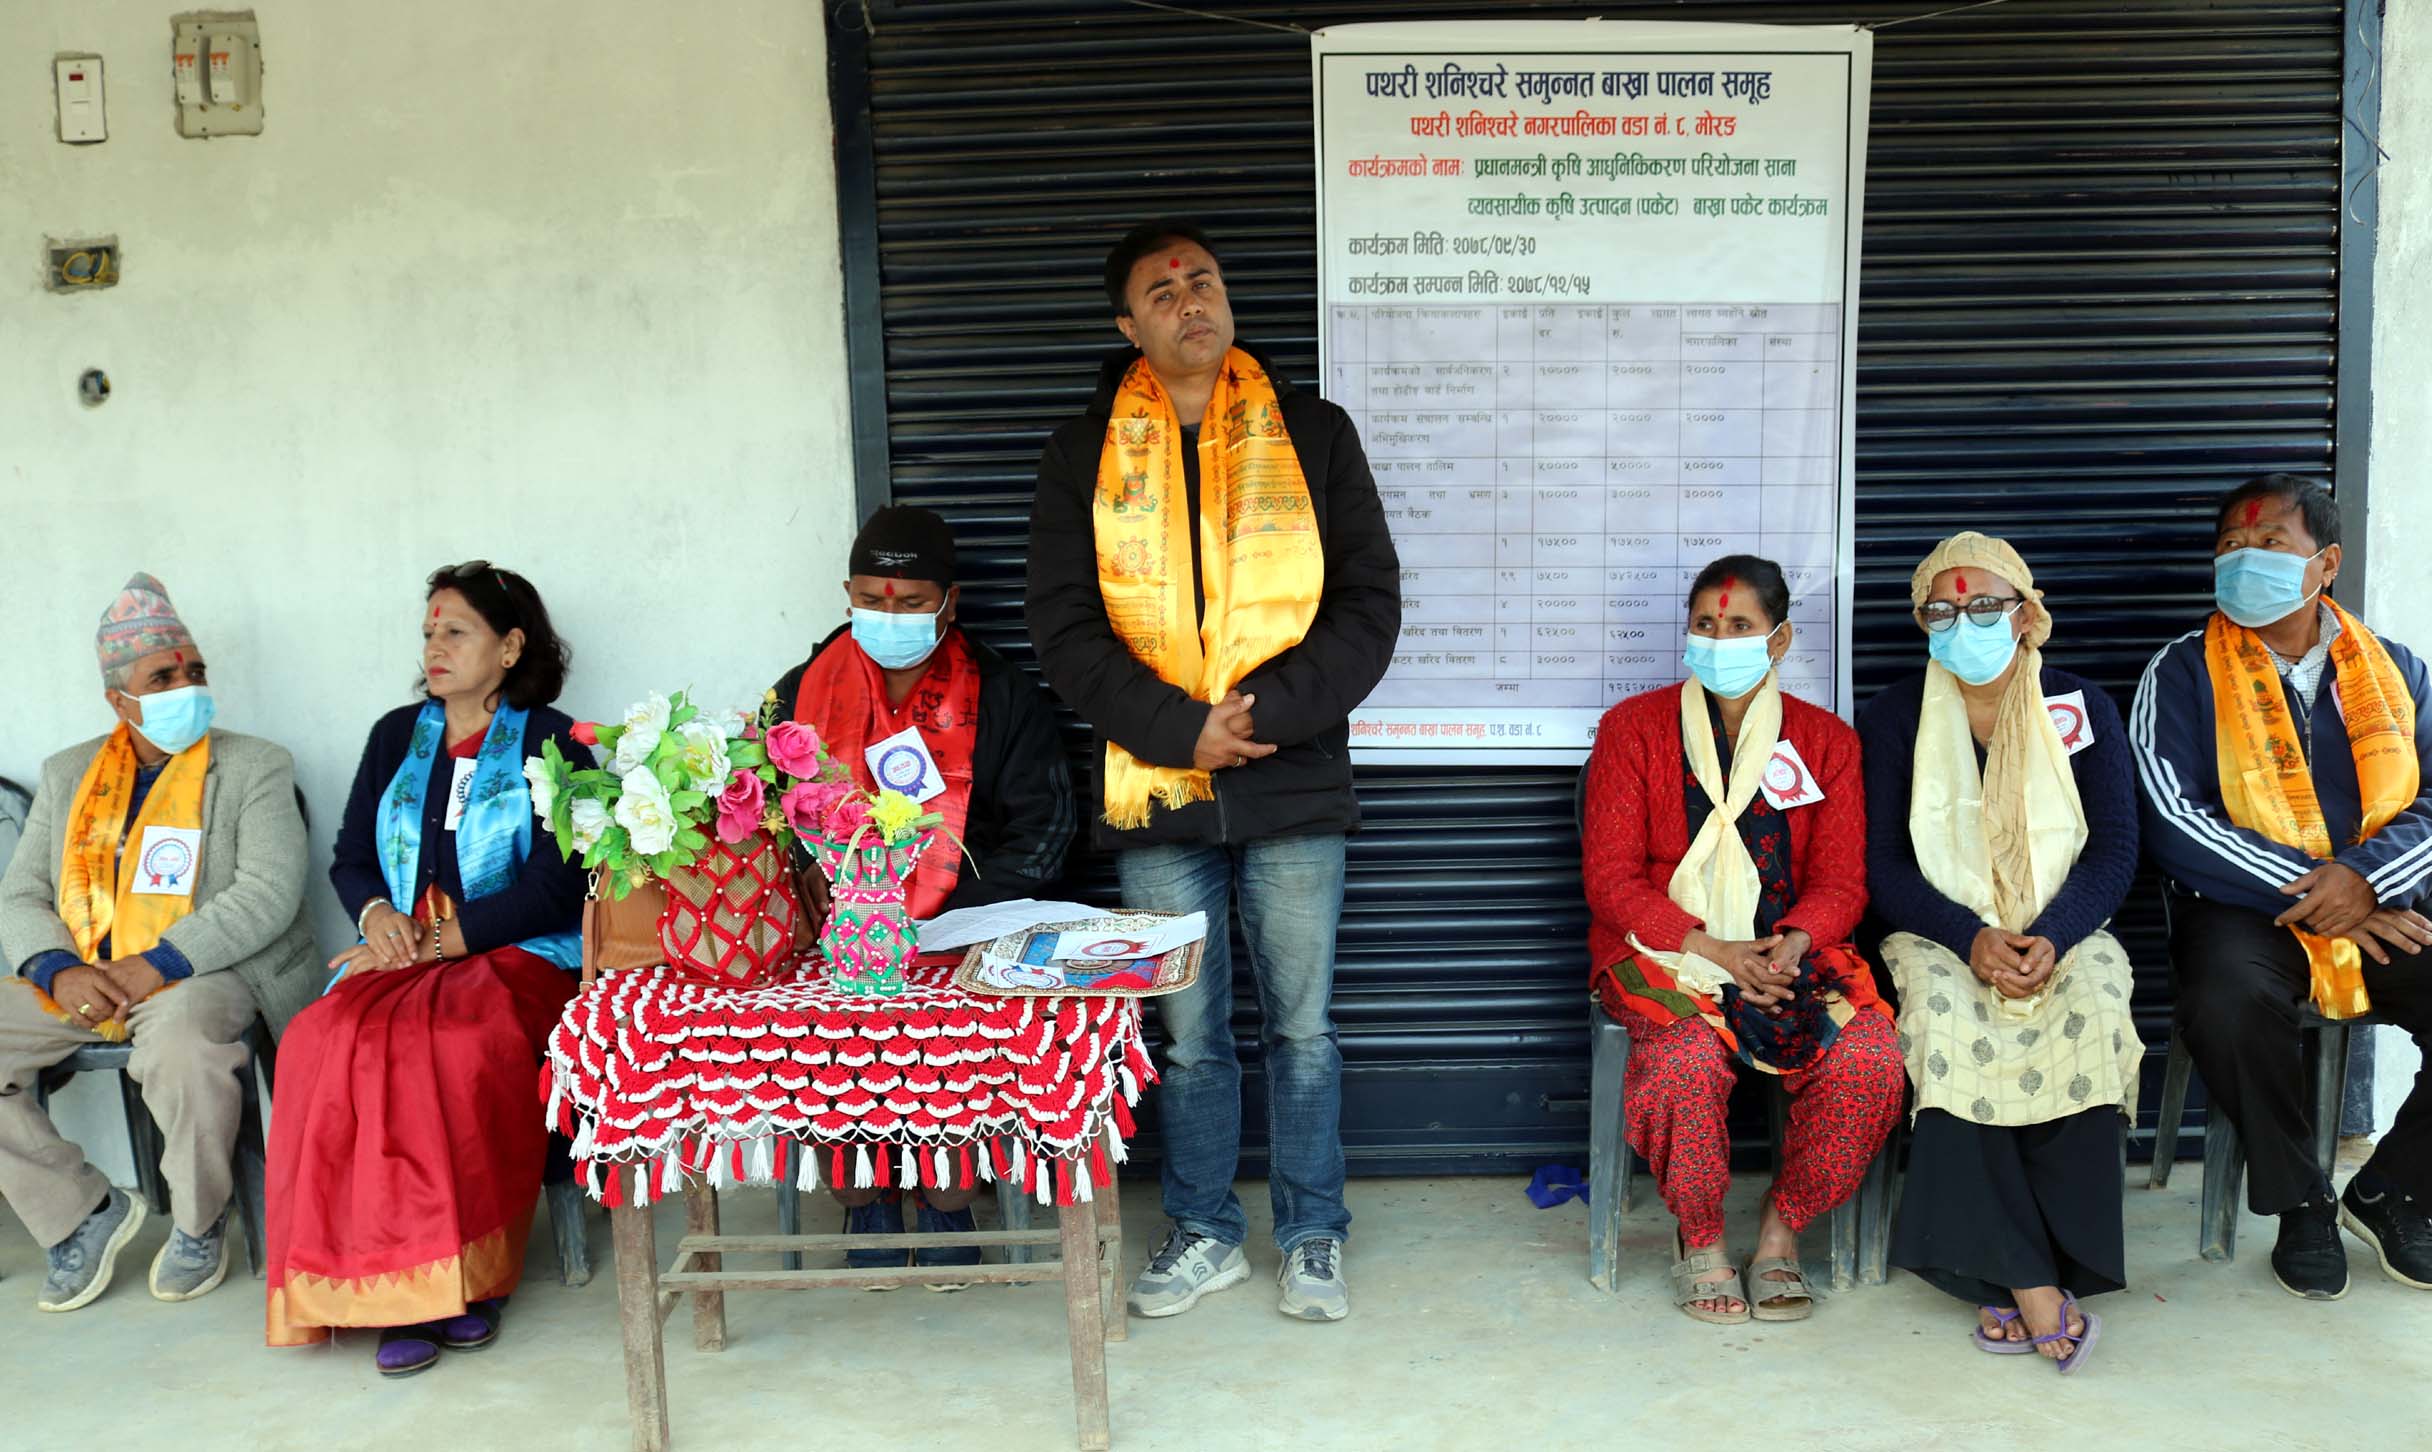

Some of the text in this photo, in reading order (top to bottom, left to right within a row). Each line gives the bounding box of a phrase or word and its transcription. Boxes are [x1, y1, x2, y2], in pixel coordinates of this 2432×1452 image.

[1366, 63, 1772, 105] पथरी शनिश्चरे समुन्नत बाख्रा पालन समूह
[1410, 111, 1450, 137] पथरी
[1456, 110, 1519, 137] शनिश्चरे
[1524, 110, 1616, 137] नगरपालिका
[1622, 116, 1649, 136] वडा
[1349, 153, 1427, 178] कार्यक्रमको
[1475, 153, 1546, 178] प्रधानमन्त्री
[1552, 153, 1581, 181] कृषि
[1587, 152, 1685, 181] आधुनिकिकरण
[1692, 152, 1759, 177] परियोजना
[1764, 159, 1796, 177] साना
[1468, 193, 1541, 217] व्यवसायीक
[1546, 192, 1575, 220] कृषि
[1579, 198, 1631, 217] उत्पादन
[1637, 192, 1679, 216] (पकेट)
[1731, 193, 1763, 216] पकेट
[1768, 194, 1827, 217] कार्यक्रम
[1348, 232, 1408, 256] कार्यक्रम
[1348, 272, 1408, 295] कार्यक्रम
[1414, 276, 1463, 295] सम्पन्न
